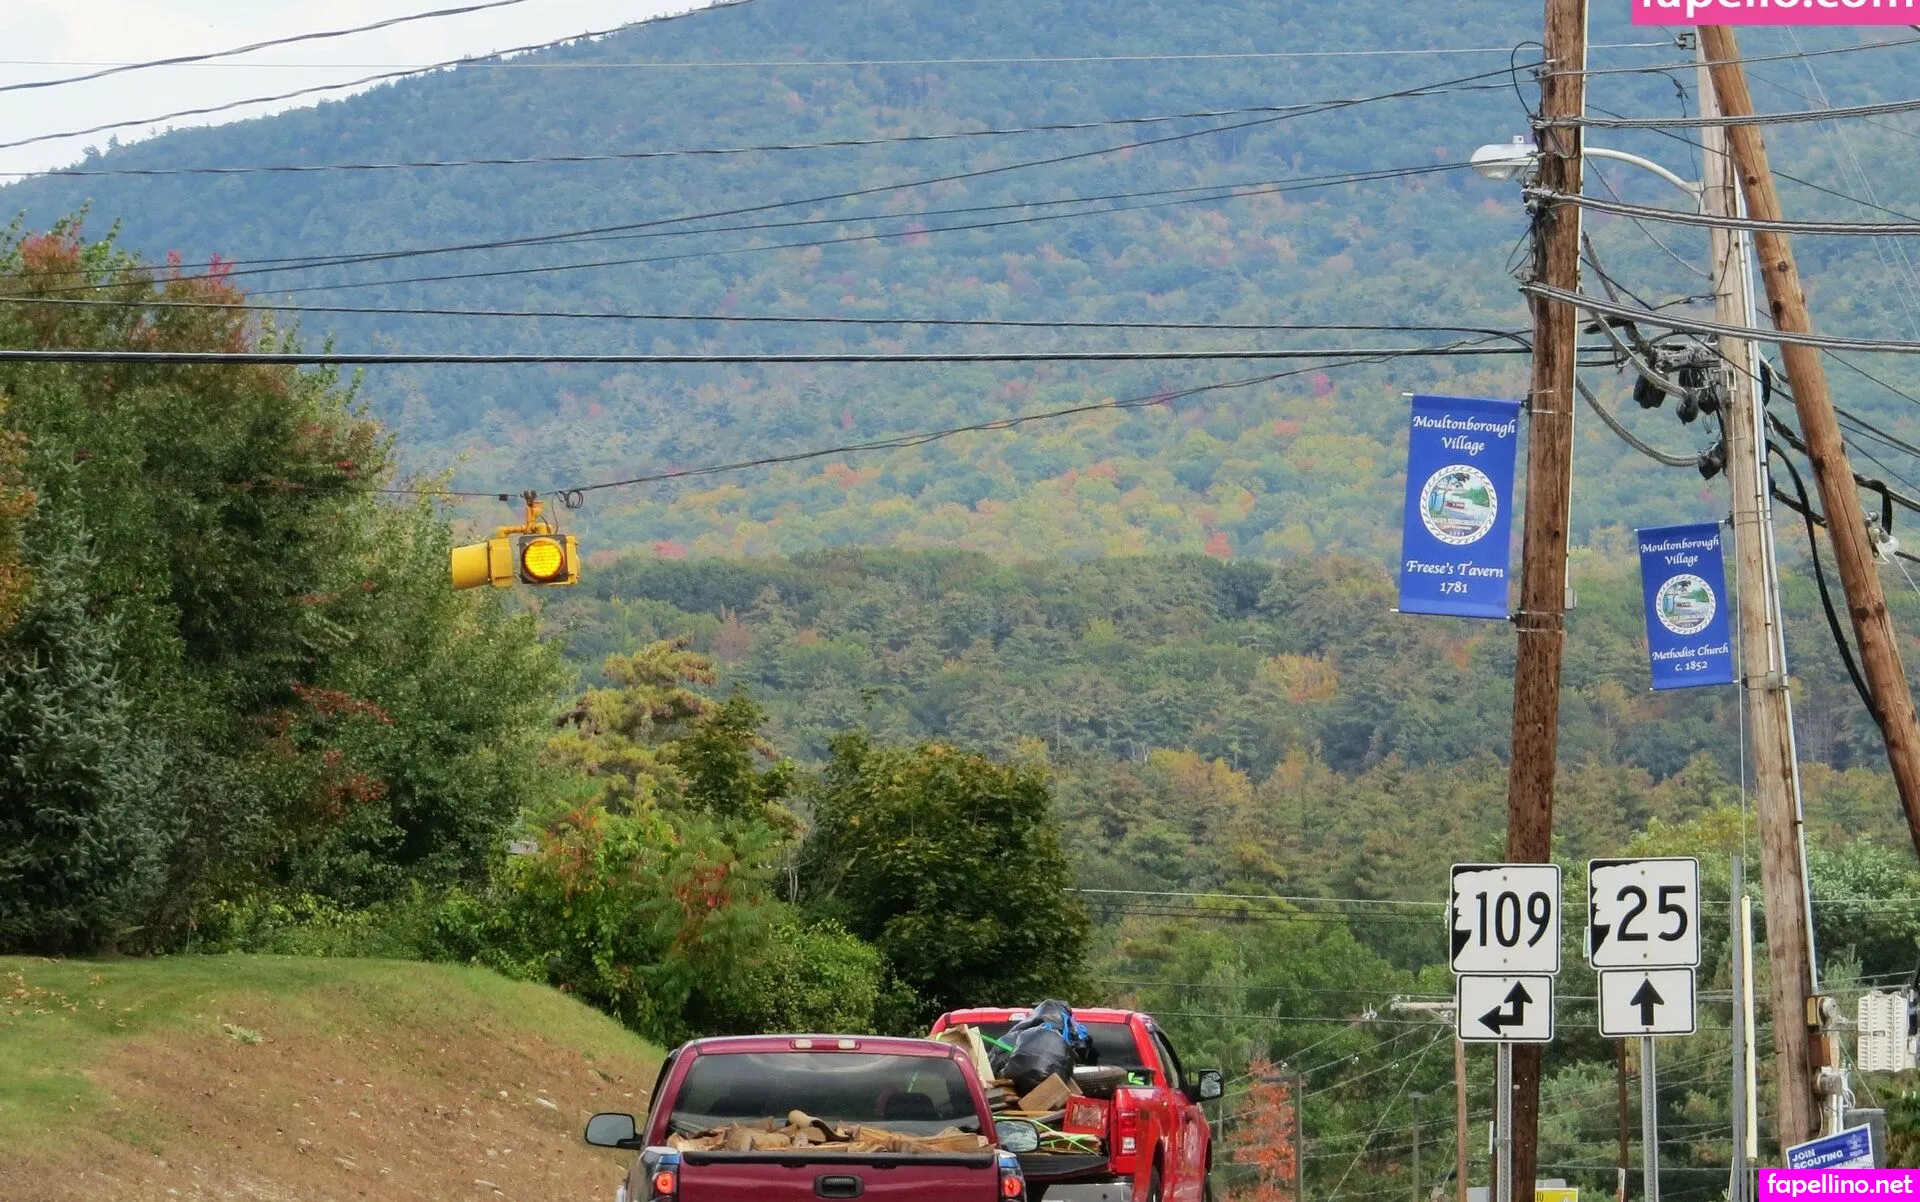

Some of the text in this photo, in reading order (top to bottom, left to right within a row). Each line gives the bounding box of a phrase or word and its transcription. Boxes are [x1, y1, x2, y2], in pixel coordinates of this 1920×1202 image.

[1413, 415, 1516, 438] Moultonborough
[1441, 435, 1485, 456] Village
[1641, 535, 1719, 553] Moultonborough
[1665, 552, 1698, 567] Village
[1406, 560, 1504, 578] Freese's Tavern
[1440, 581, 1468, 594] 1781
[1652, 642, 1729, 660] Methodist Church
[1674, 660, 1708, 671] c. 1852
[1475, 890, 1551, 948] 109
[1616, 885, 1688, 942] 25
[1791, 1148, 1816, 1162] JOIN
[1793, 1149, 1844, 1169] SCOUTING
